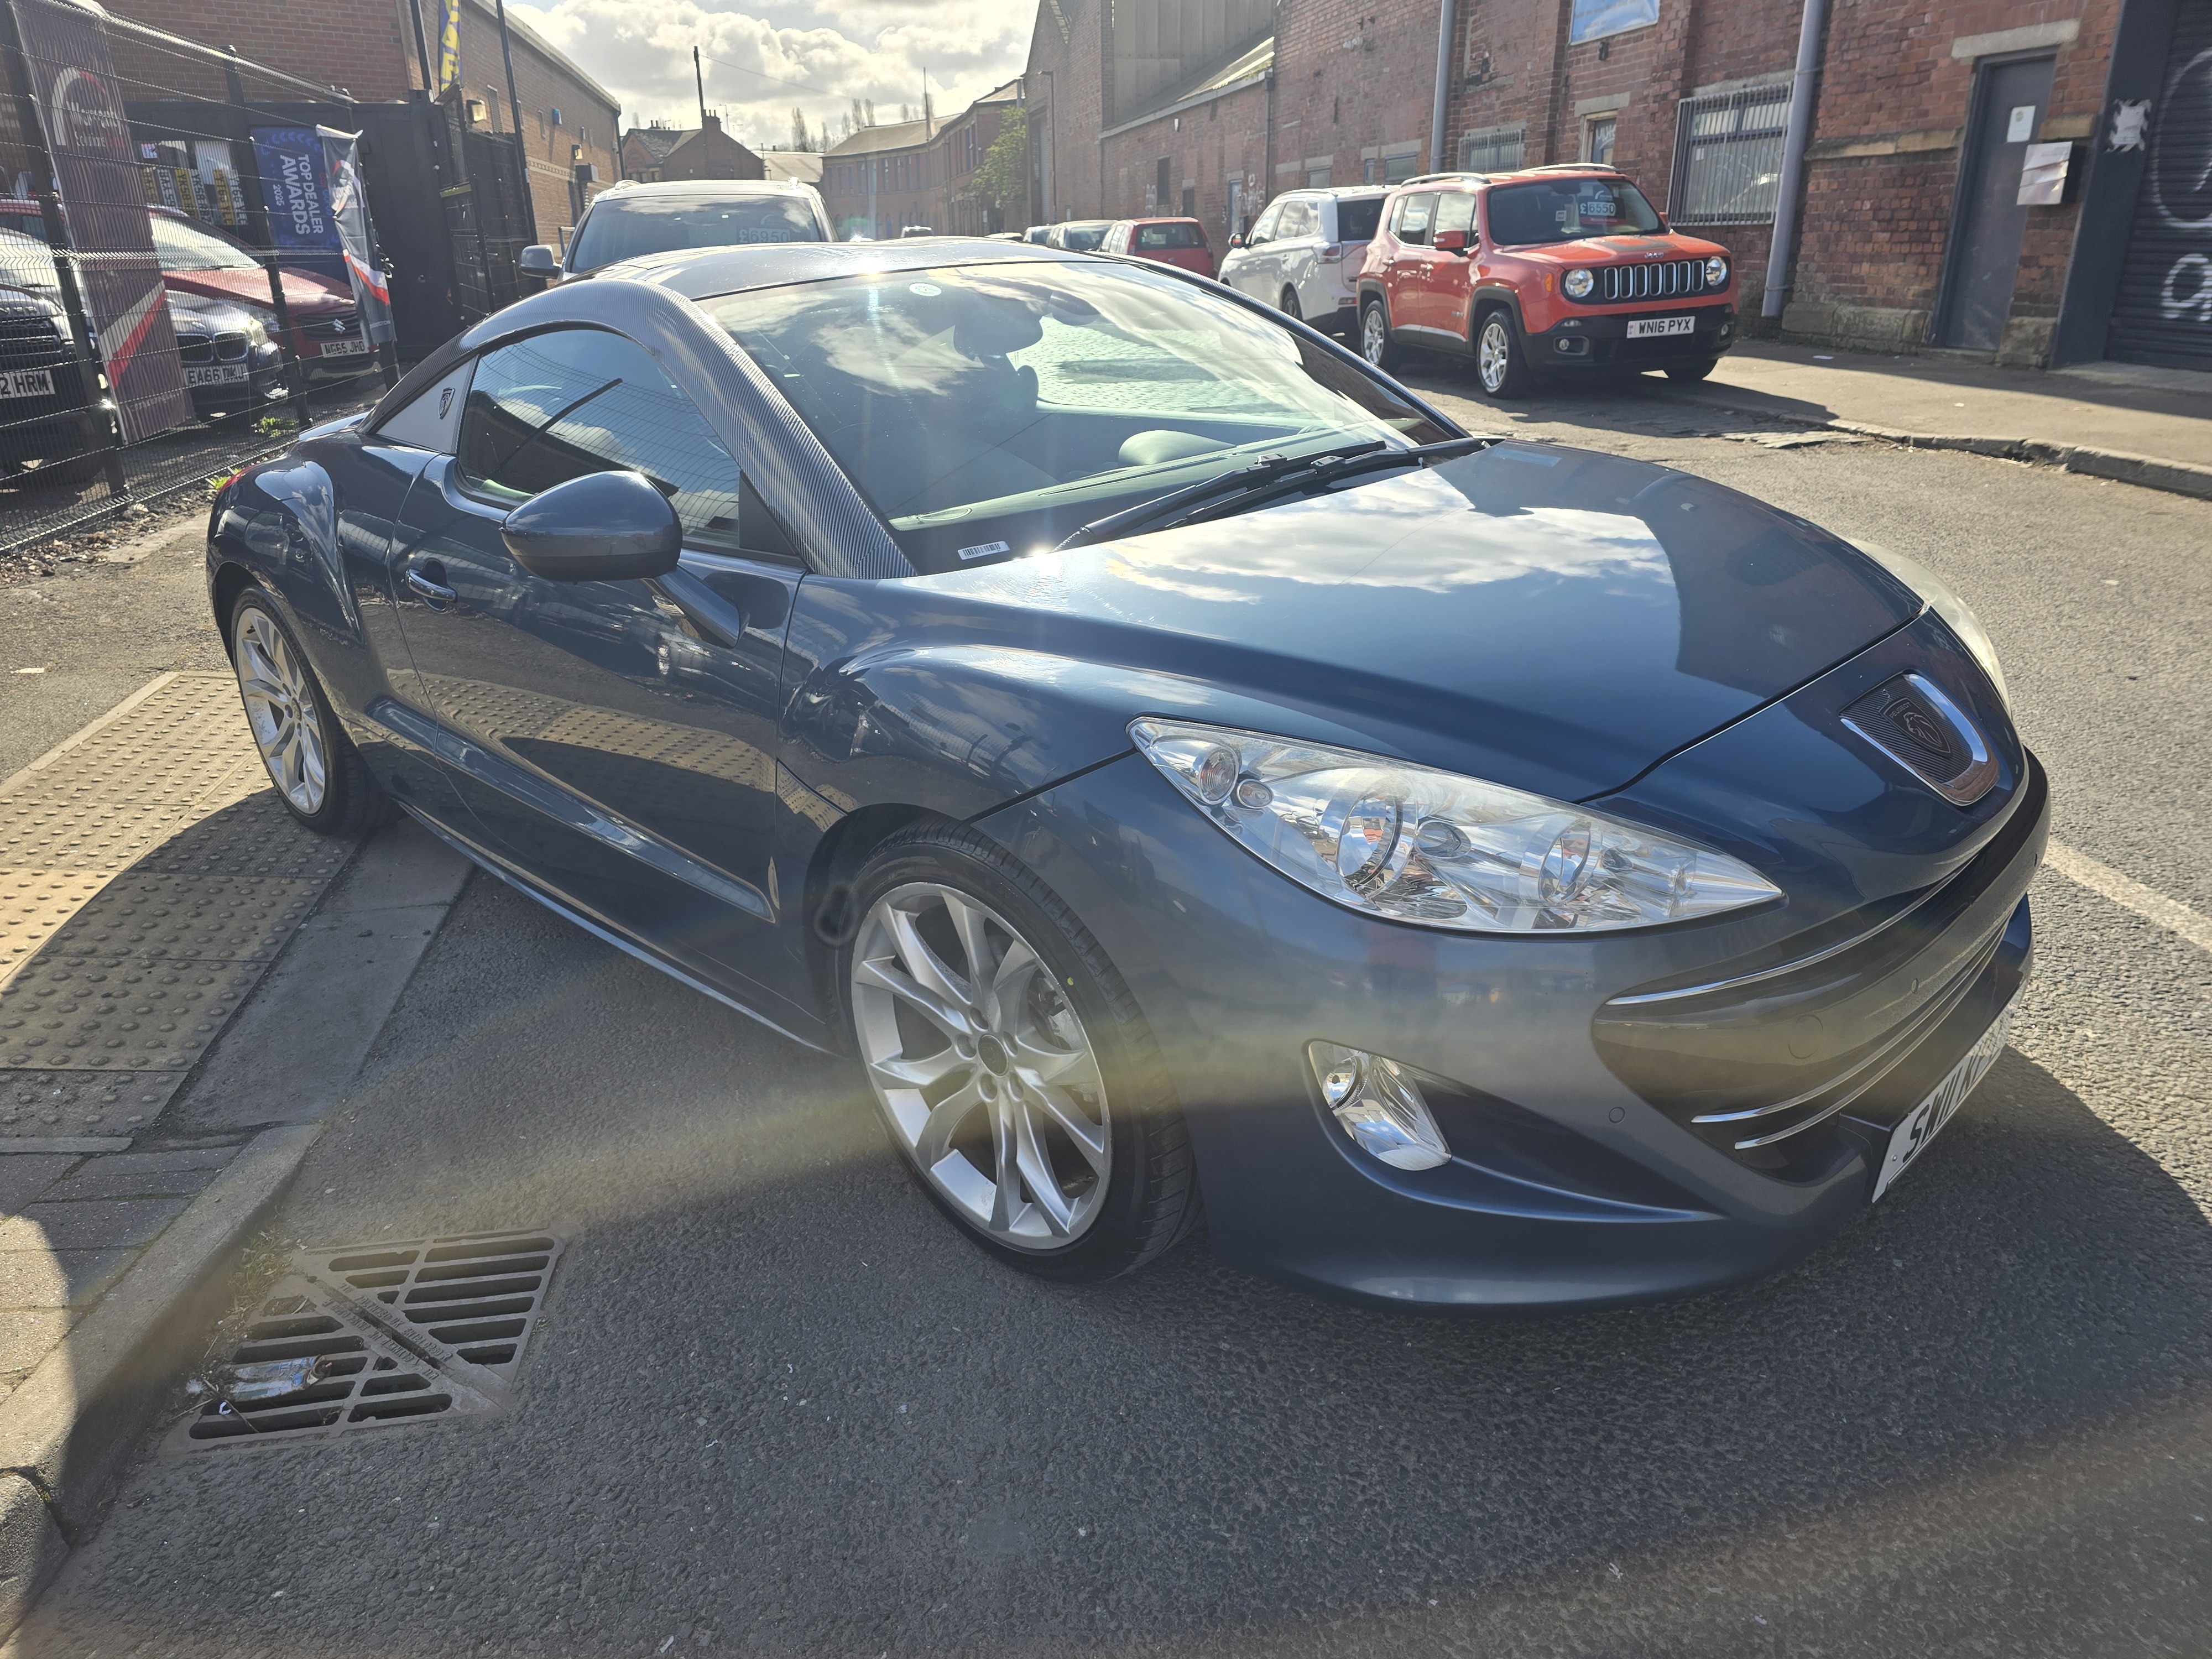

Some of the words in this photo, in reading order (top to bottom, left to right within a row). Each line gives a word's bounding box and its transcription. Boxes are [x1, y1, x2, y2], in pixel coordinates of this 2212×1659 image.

[298, 154, 312, 181] TOP
[279, 154, 311, 234] AWARDS
[302, 182, 324, 234] DEALER
[1579, 203, 1615, 214] £6550
[739, 229, 789, 243] £6950
[1639, 320, 1666, 335] WN16
[1668, 318, 1691, 332] PYX
[13, 373, 50, 394] HRM
[187, 368, 221, 385] EA66
[1889, 702, 1912, 719] PEUGEOT
